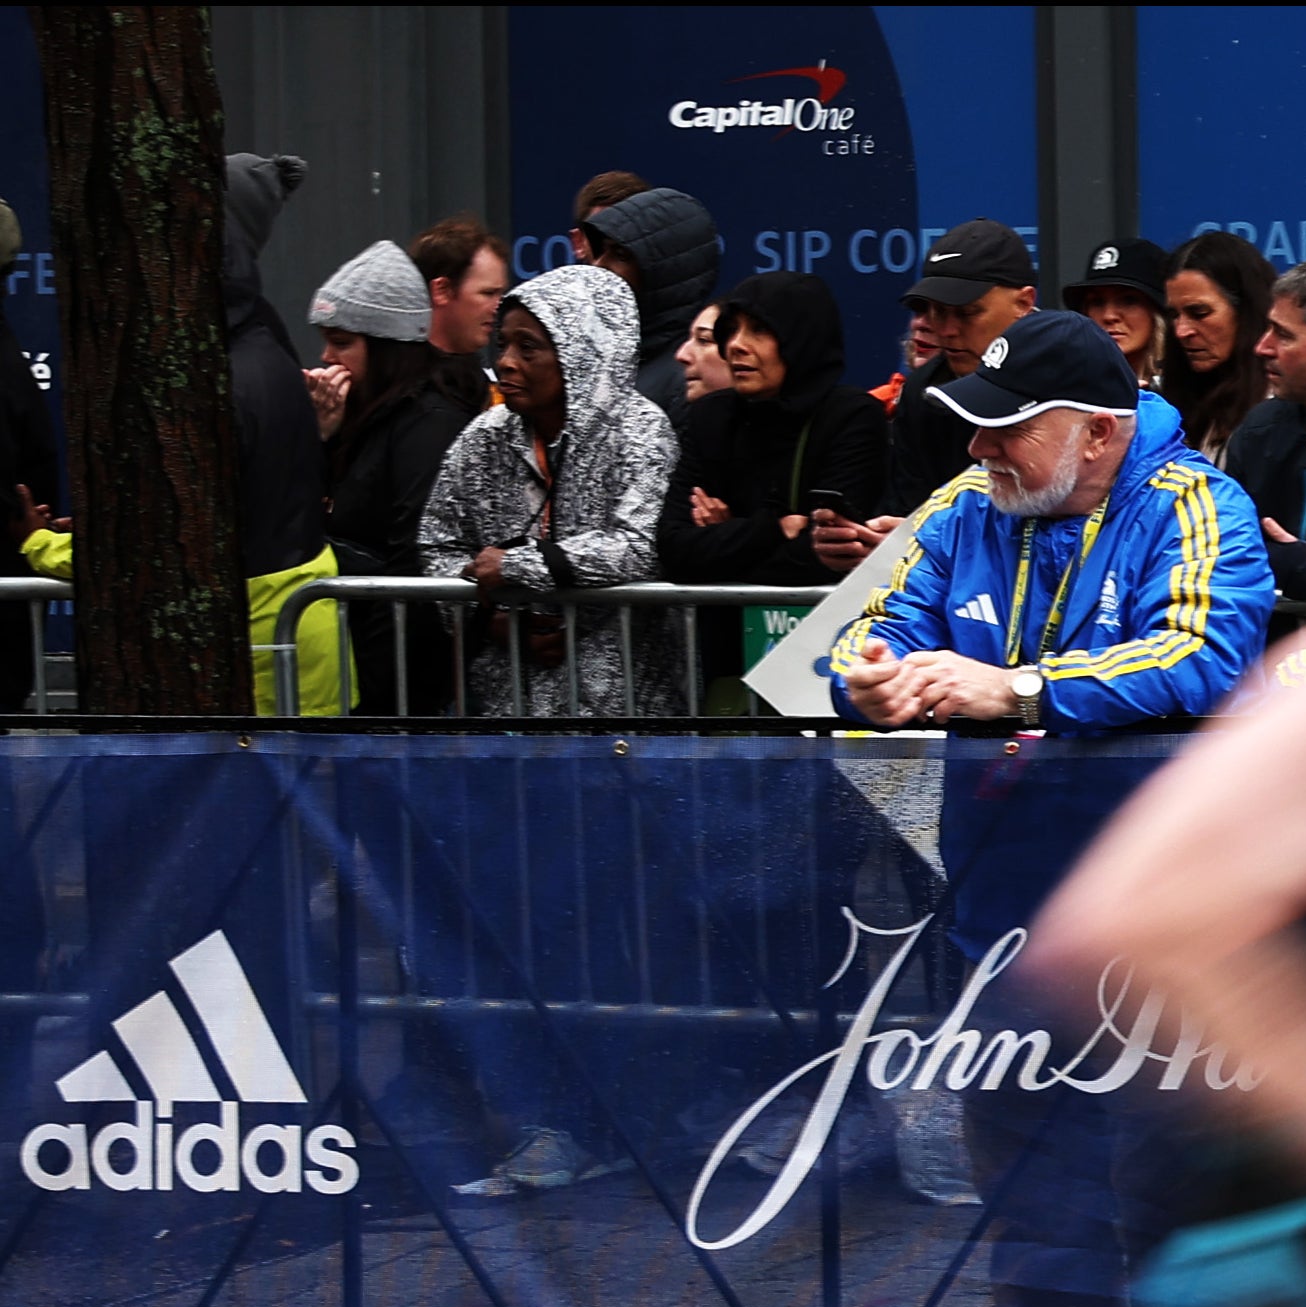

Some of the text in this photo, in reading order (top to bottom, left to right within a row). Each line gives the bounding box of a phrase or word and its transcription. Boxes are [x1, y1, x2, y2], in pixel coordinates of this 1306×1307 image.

[823, 133, 875, 155] café
[755, 231, 831, 274] SIP
[687, 906, 1056, 1250] John
[20, 1100, 361, 1195] adidas
